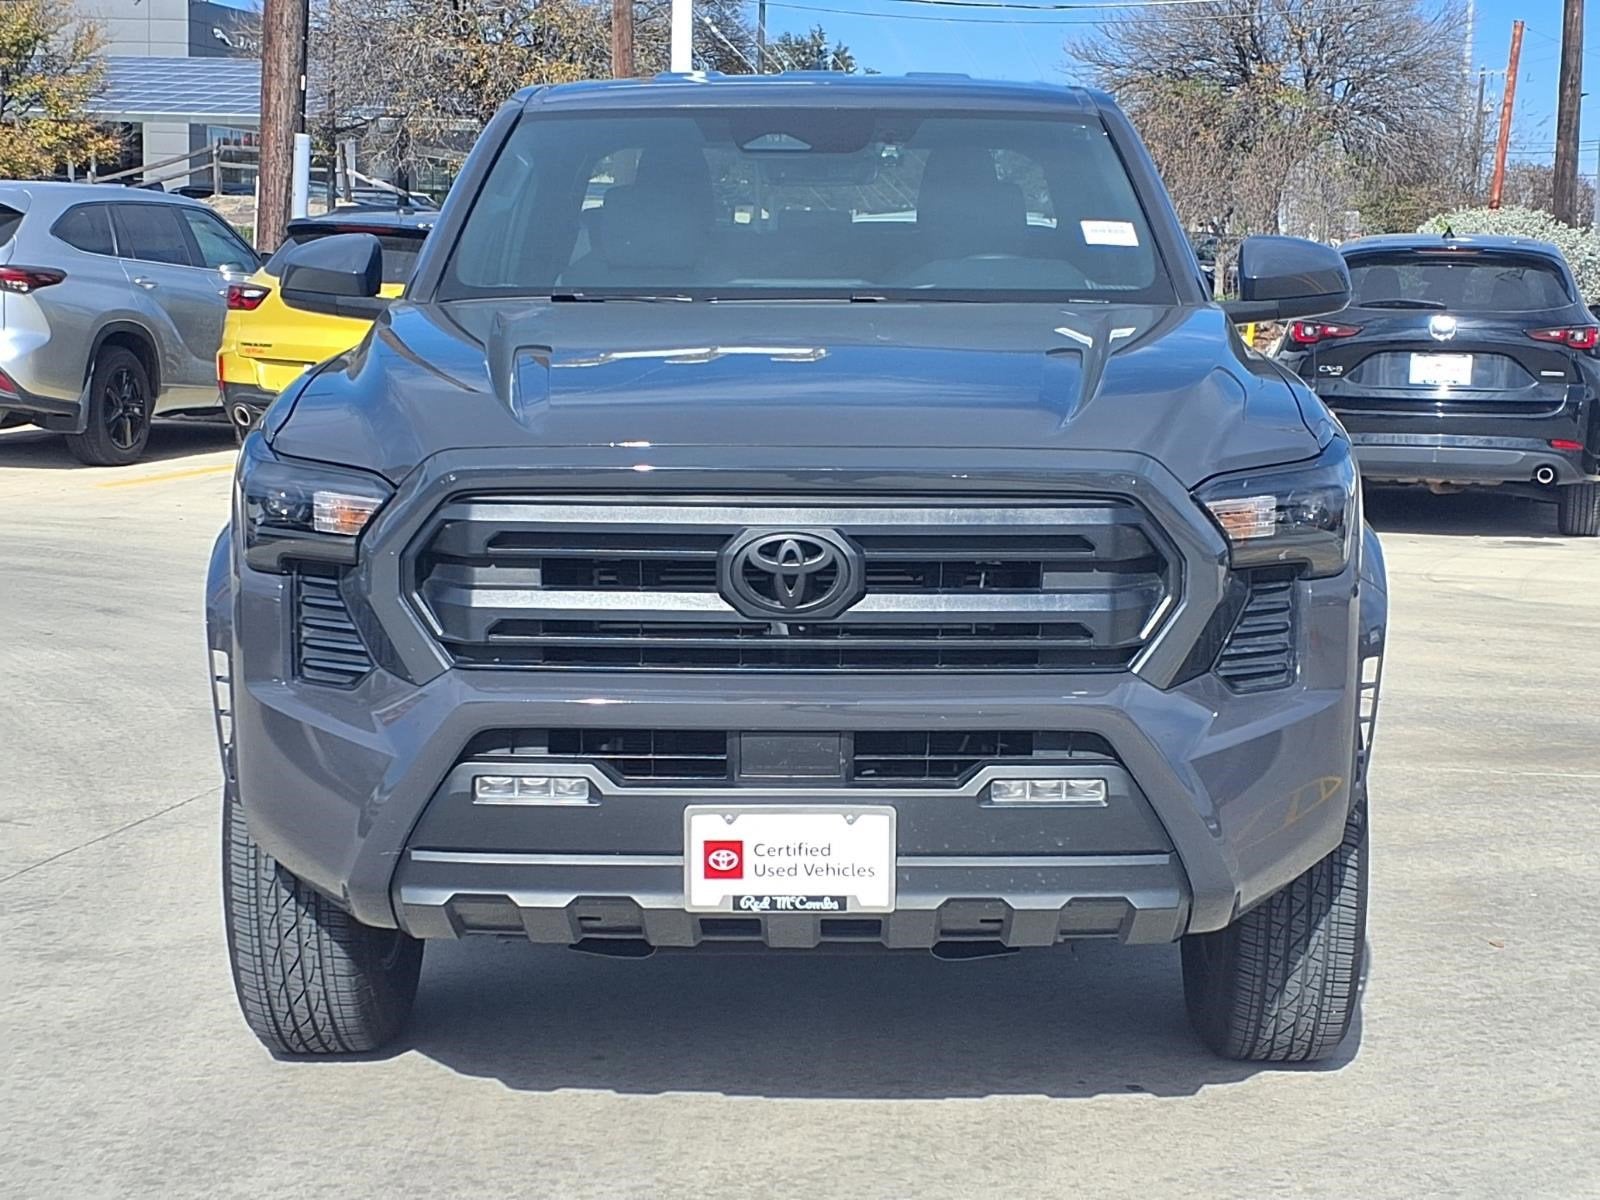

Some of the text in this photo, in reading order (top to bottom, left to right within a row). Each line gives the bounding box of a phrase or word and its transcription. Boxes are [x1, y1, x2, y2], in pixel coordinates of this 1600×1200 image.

[754, 843, 831, 856] Certified
[754, 863, 875, 877] Used Vehicles
[740, 895, 839, 912] Red McCombs
